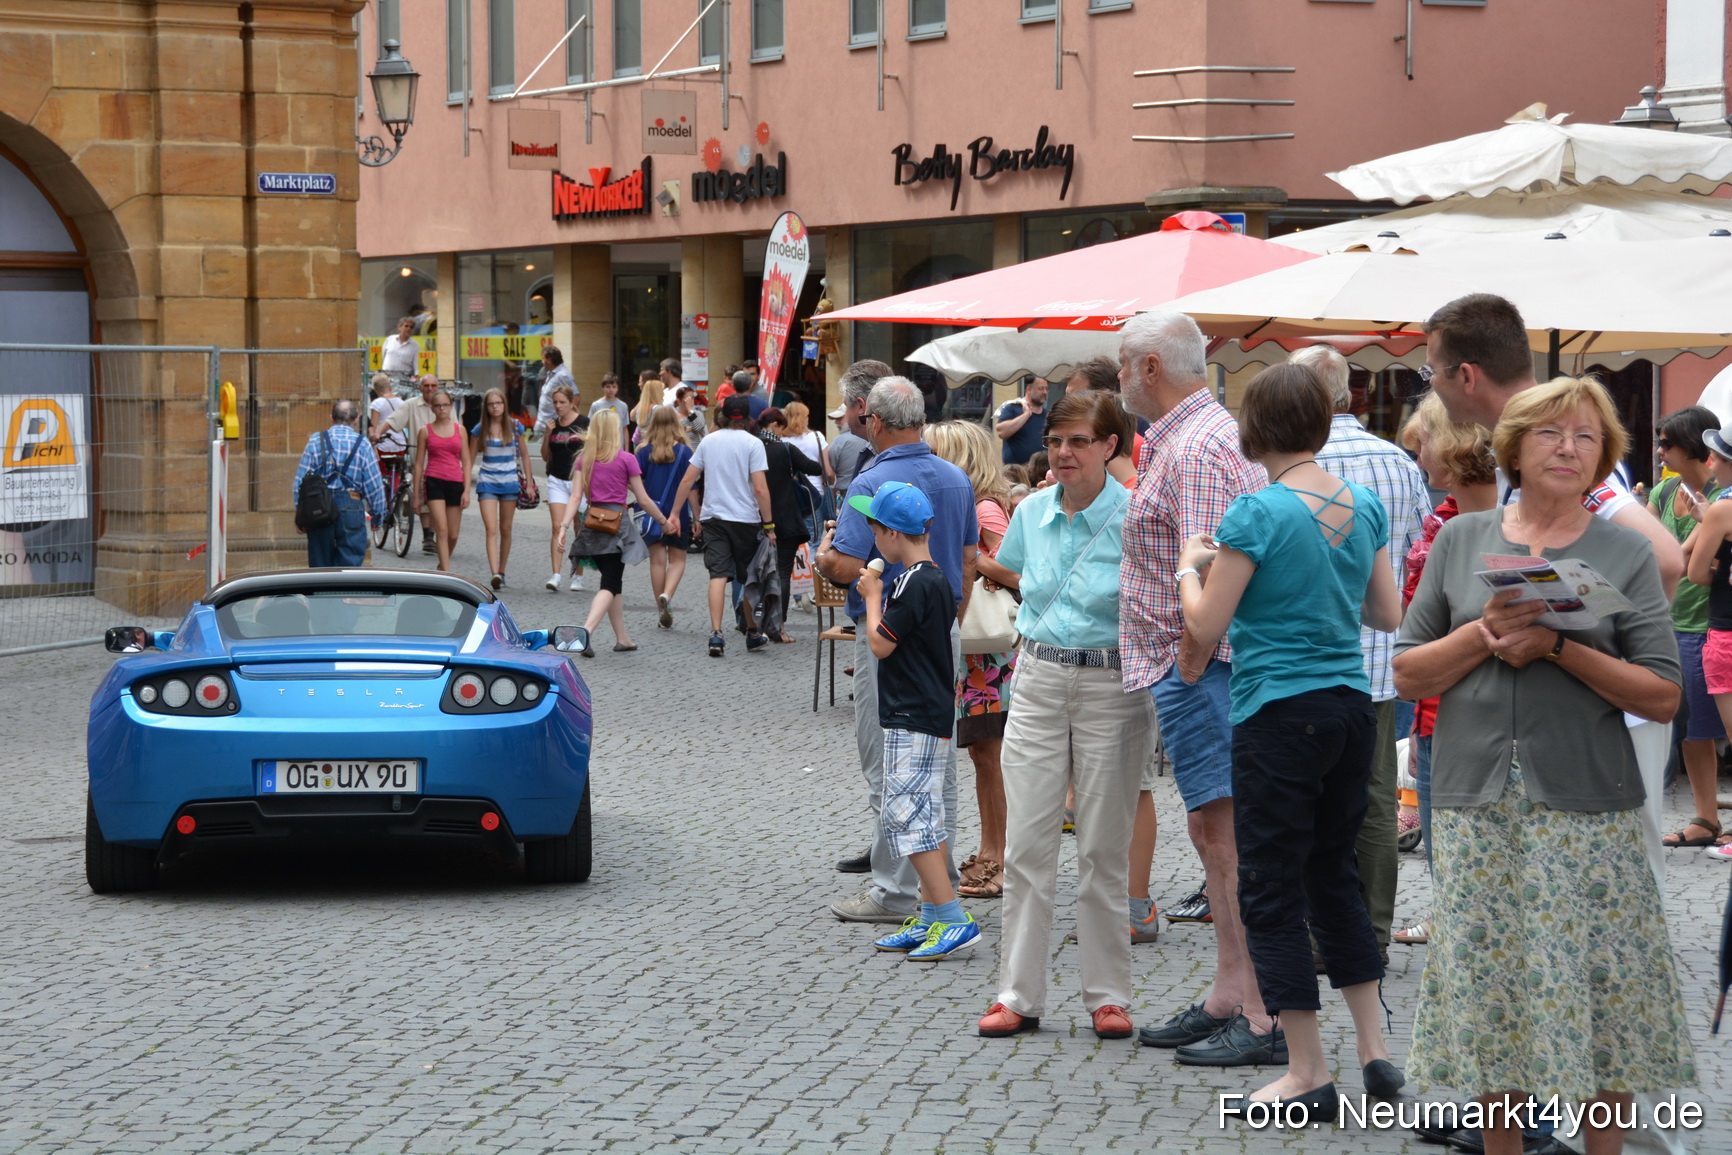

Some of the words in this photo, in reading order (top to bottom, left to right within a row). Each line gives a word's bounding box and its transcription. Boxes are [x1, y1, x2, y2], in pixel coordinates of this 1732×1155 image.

[648, 124, 692, 138] moedel
[692, 151, 786, 203] moedel
[891, 143, 962, 211] Betty
[967, 125, 1074, 201] Barclay
[264, 175, 331, 193] Marktplatz
[769, 240, 807, 262] moedel
[467, 338, 489, 357] SALE
[503, 338, 526, 357] SALE
[422, 358, 429, 372] 4
[0, 553, 17, 566] O
[23, 551, 82, 565] MODA
[266, 780, 272, 788] D
[286, 764, 319, 789] OG
[337, 764, 369, 788] UX
[377, 764, 407, 788] 90
